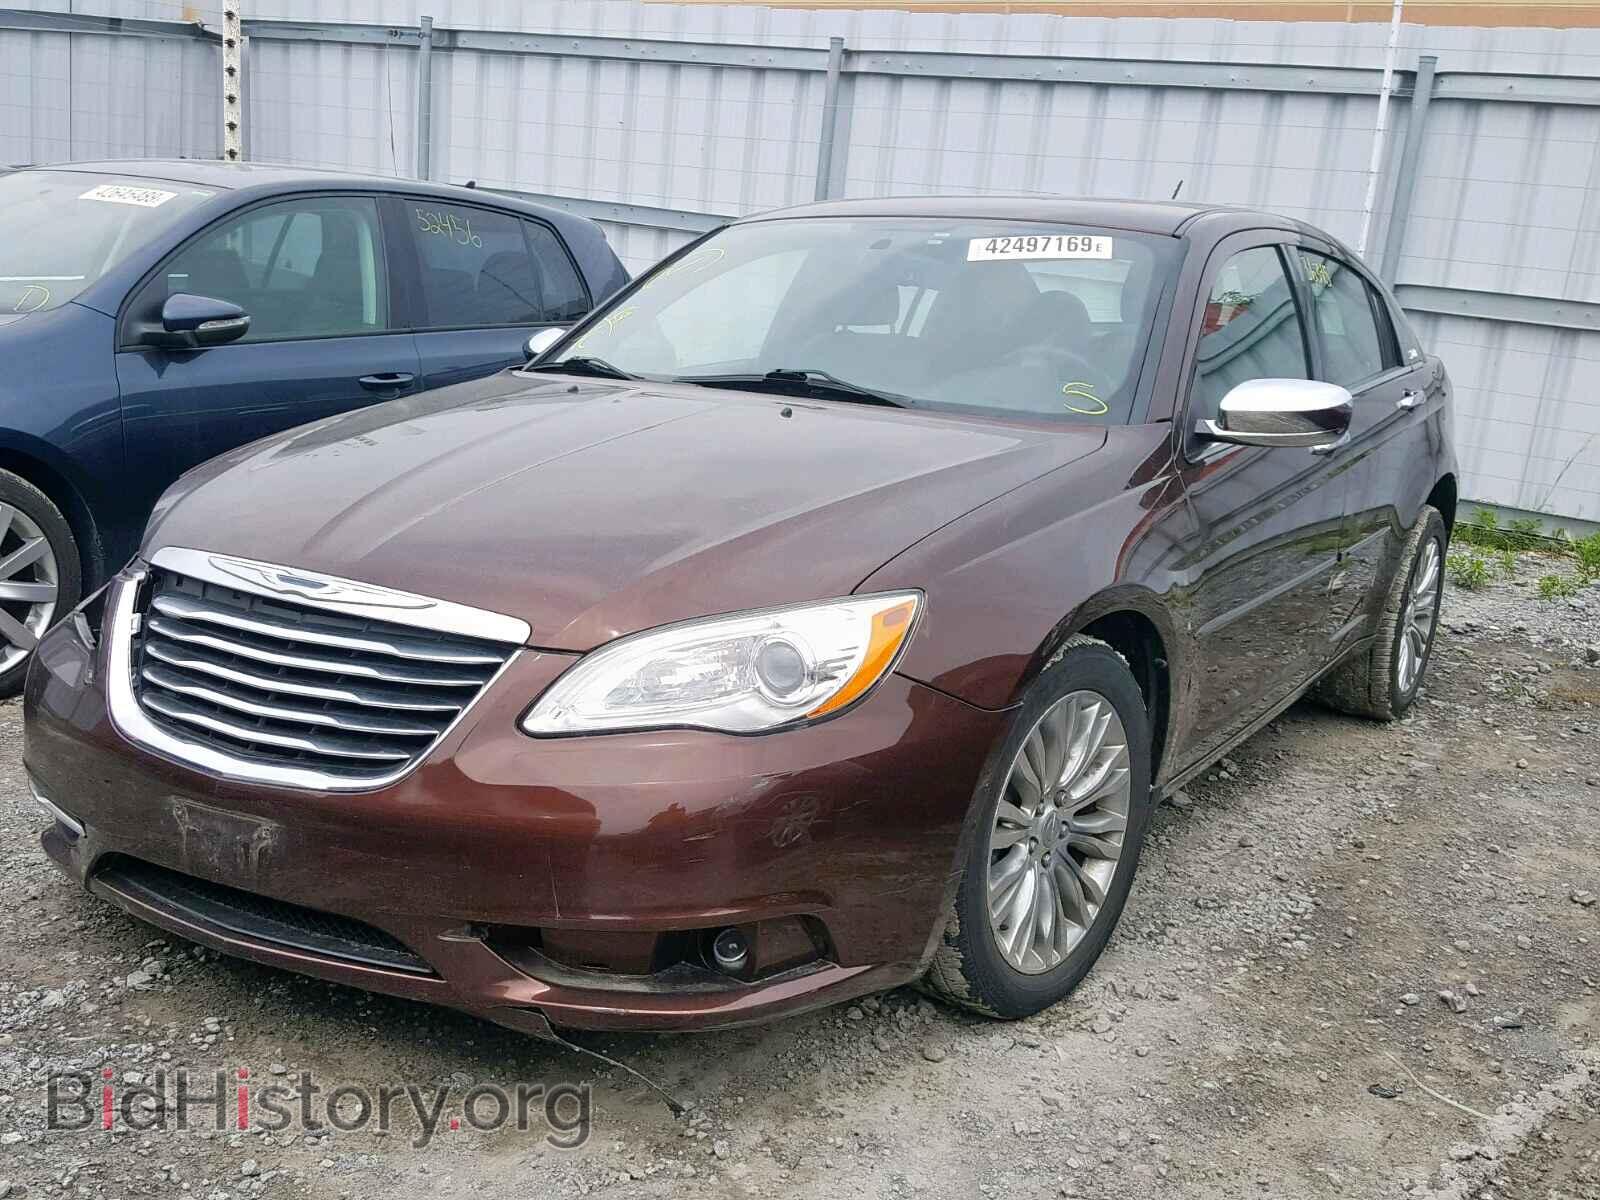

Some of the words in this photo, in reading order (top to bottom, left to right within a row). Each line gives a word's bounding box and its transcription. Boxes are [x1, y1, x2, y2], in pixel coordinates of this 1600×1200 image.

[415, 208, 482, 248] 52456
[985, 236, 1092, 254] 42497169
[1062, 382, 1108, 414] S
